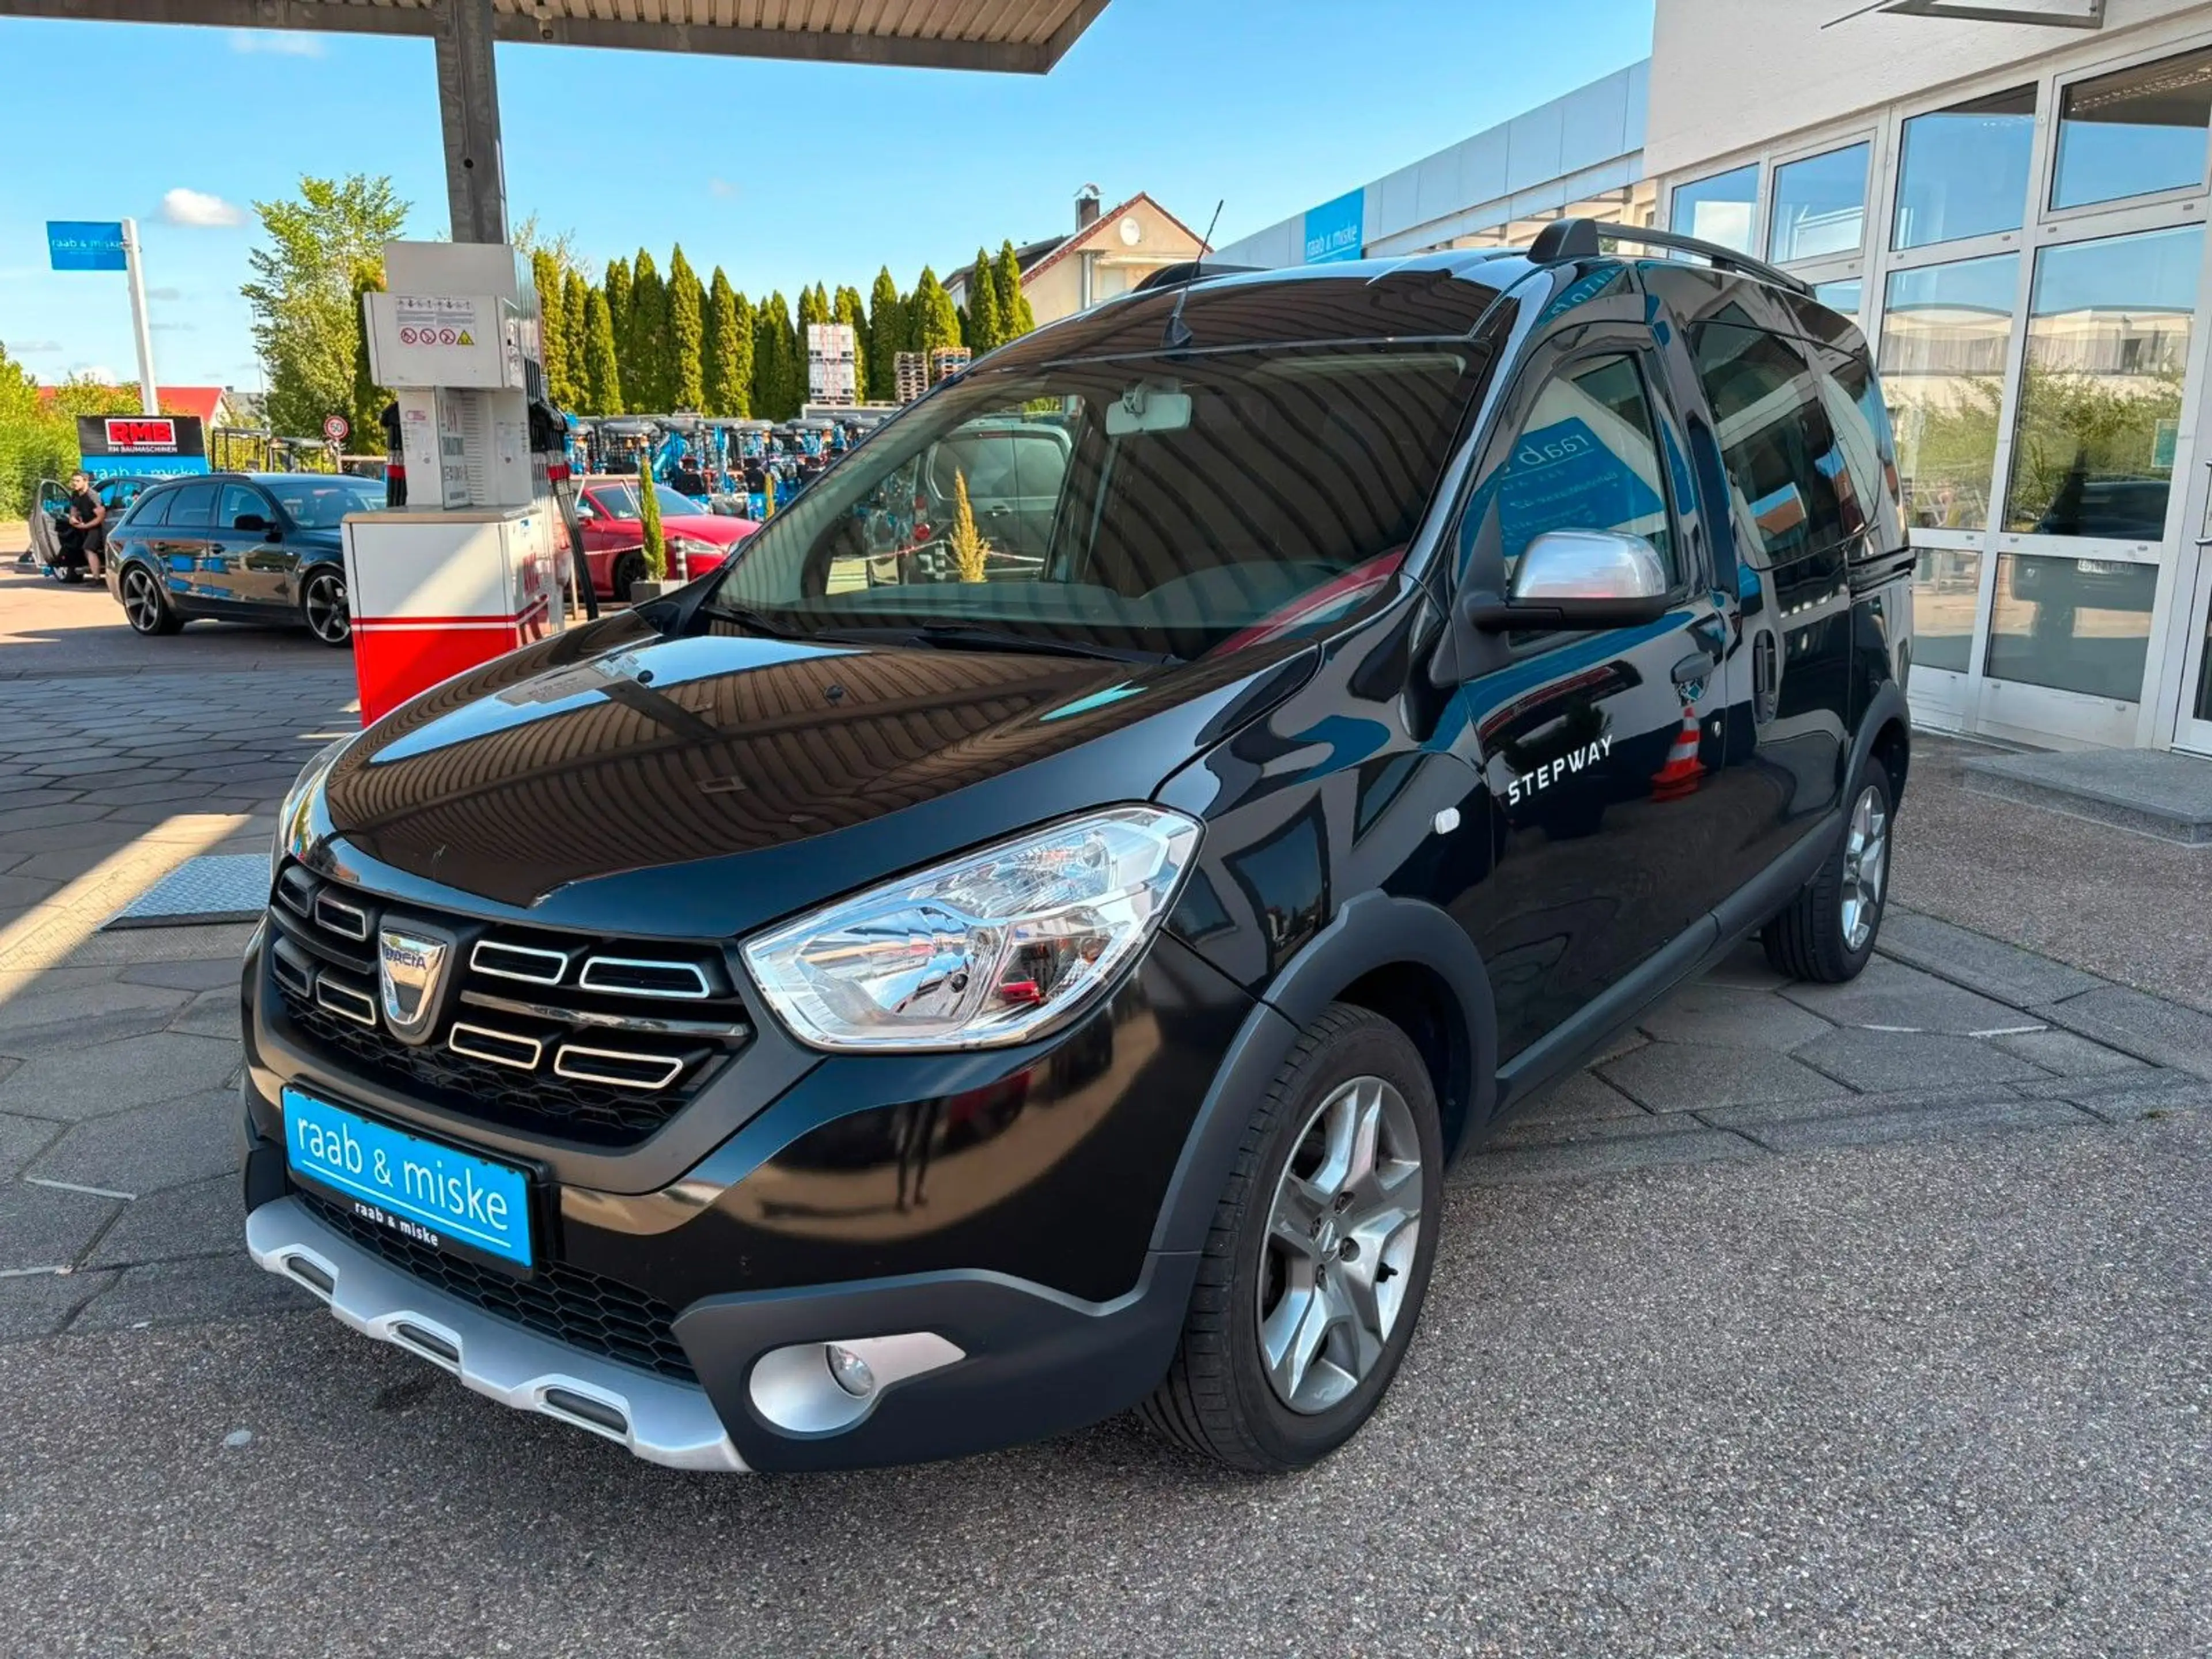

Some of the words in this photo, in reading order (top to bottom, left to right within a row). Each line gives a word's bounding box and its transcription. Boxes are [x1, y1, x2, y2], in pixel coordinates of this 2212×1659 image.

[1306, 233, 1325, 256] raab
[1332, 221, 1357, 248] miske
[109, 422, 172, 446] RMB
[1508, 734, 1613, 806] STEPWAY
[385, 949, 427, 970] DACIA
[298, 1118, 362, 1174] raab
[374, 1149, 393, 1188] &
[404, 1160, 508, 1231] miske
[355, 1202, 384, 1223] raab
[387, 1215, 396, 1228] &
[400, 1221, 438, 1247] miske
